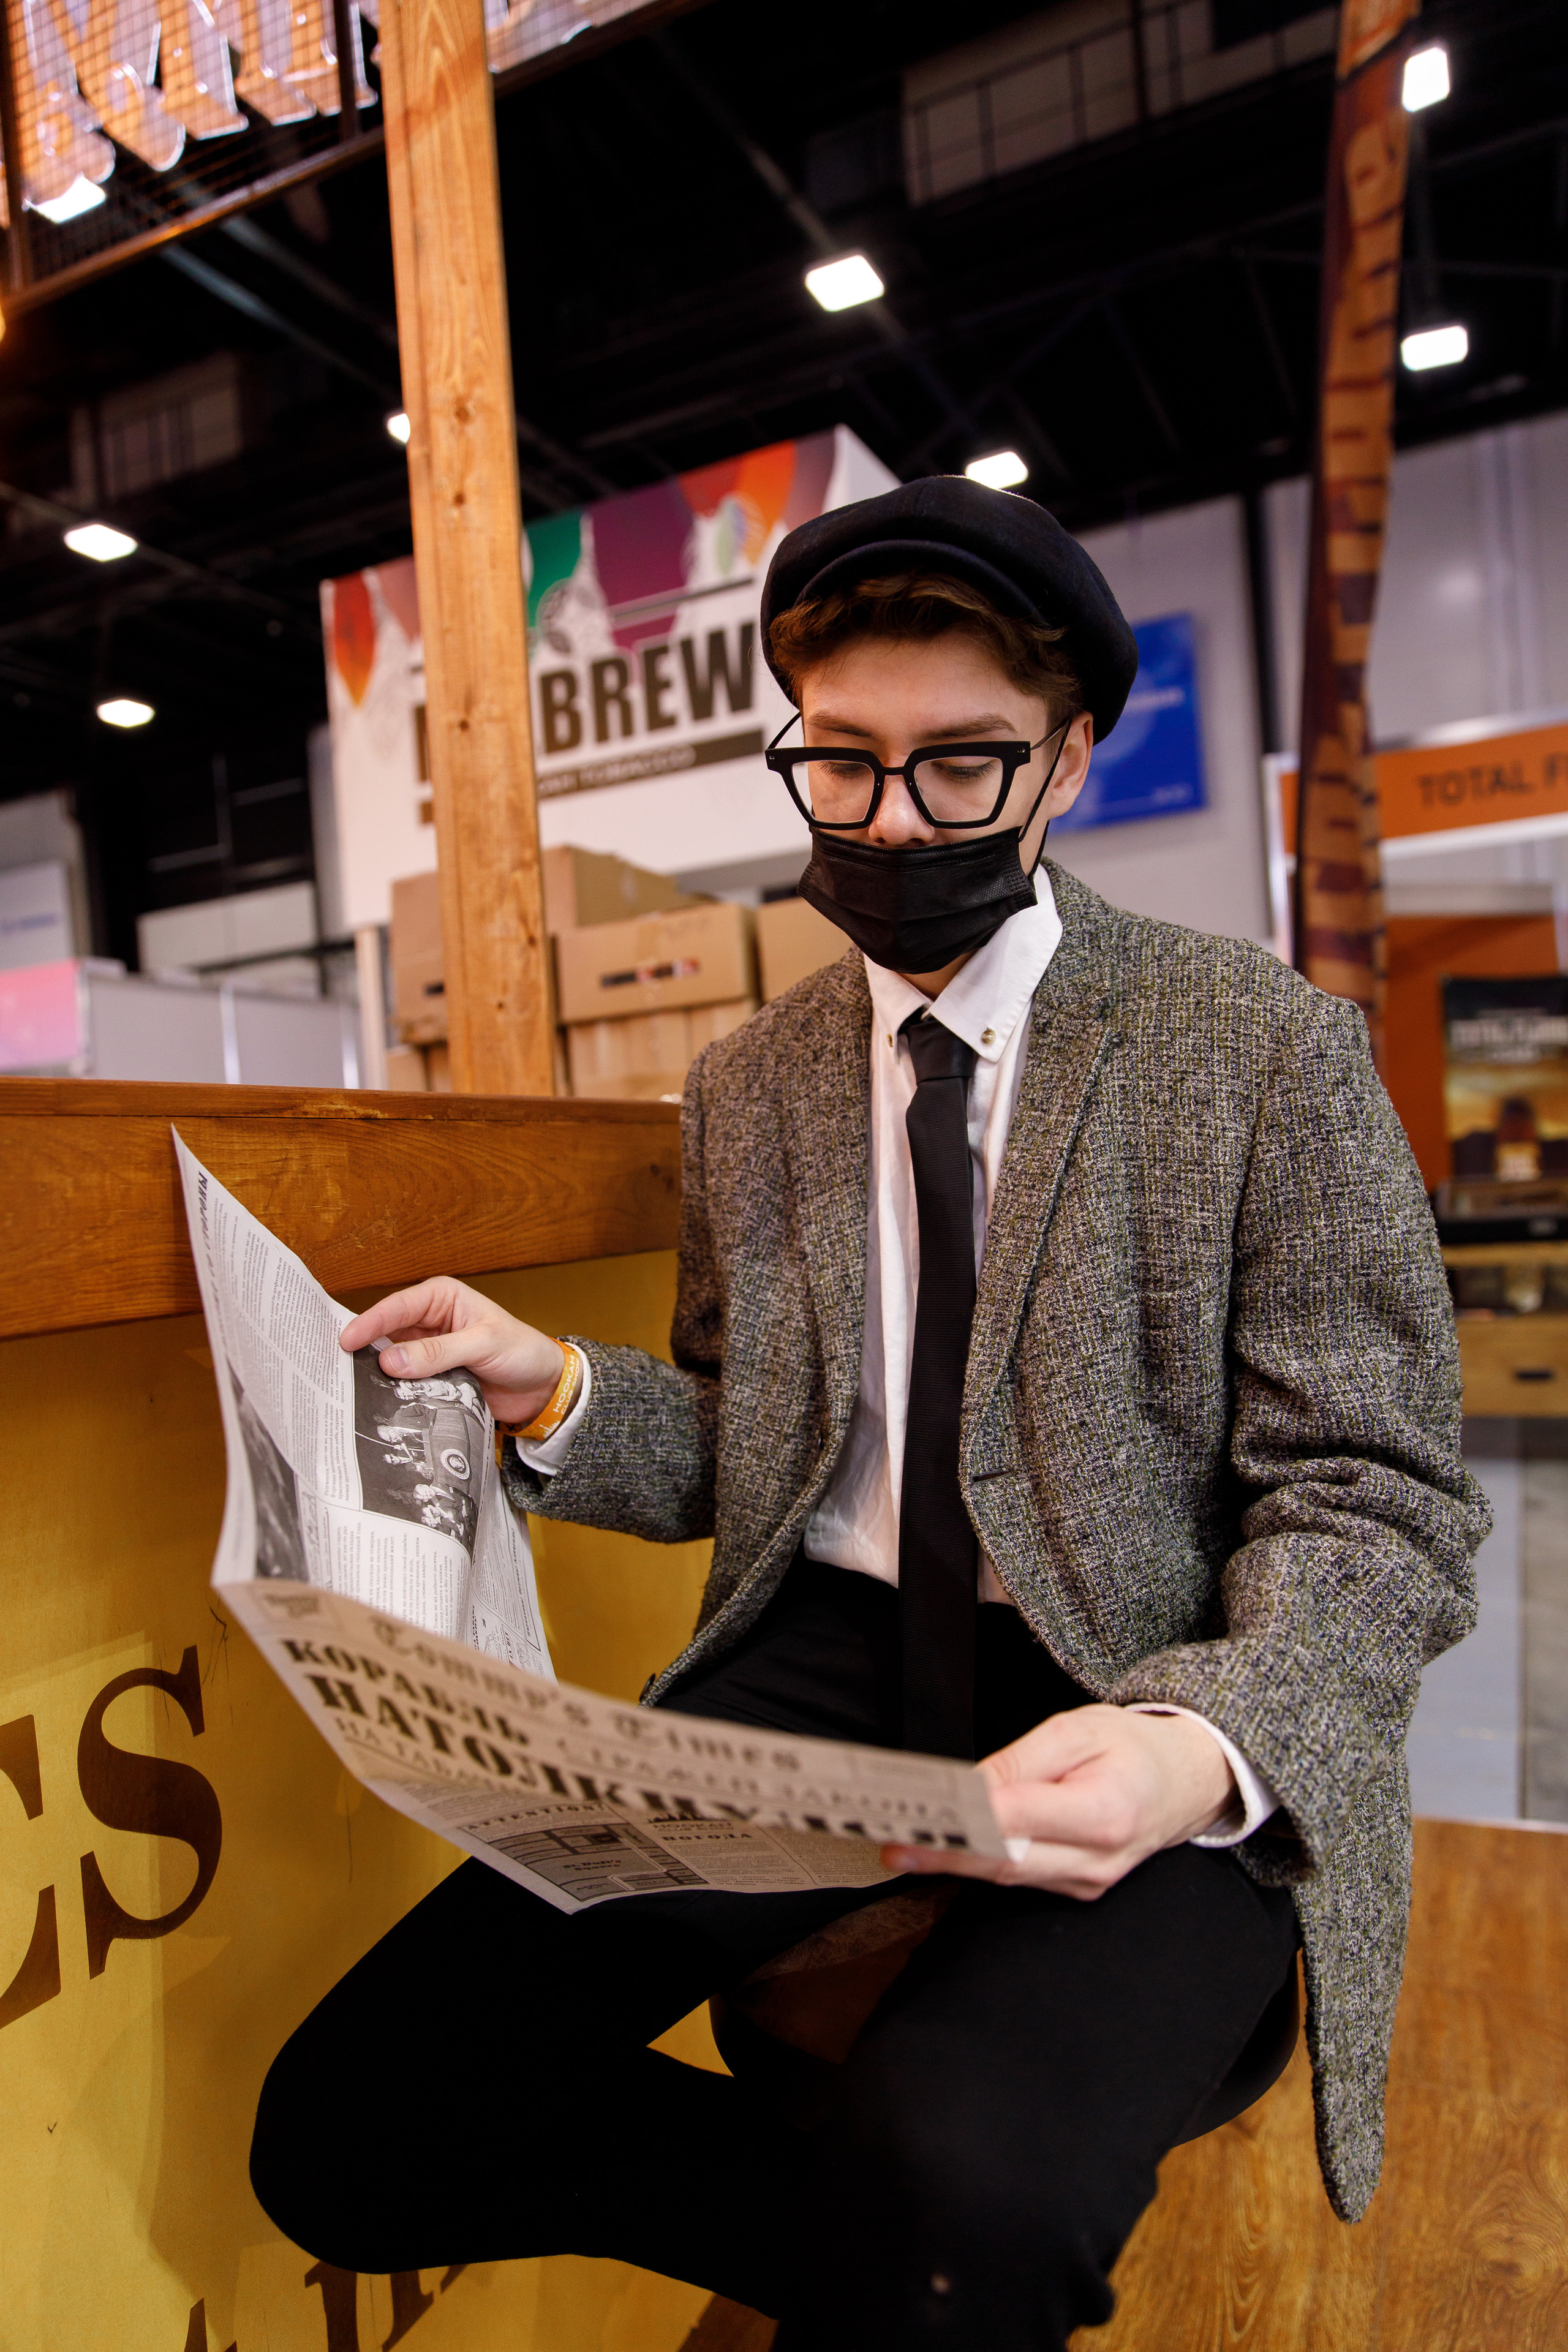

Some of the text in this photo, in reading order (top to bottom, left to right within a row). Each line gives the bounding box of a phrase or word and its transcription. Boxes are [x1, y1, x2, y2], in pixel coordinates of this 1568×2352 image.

[1417, 759, 1535, 807] TOTAL
[552, 1355, 575, 1414] HOOKAH
[571, 1358, 580, 1387] SHOW
[281, 1638, 529, 1746] КОРАБЛЬ
[467, 1803, 605, 1830] ATTENTION!
